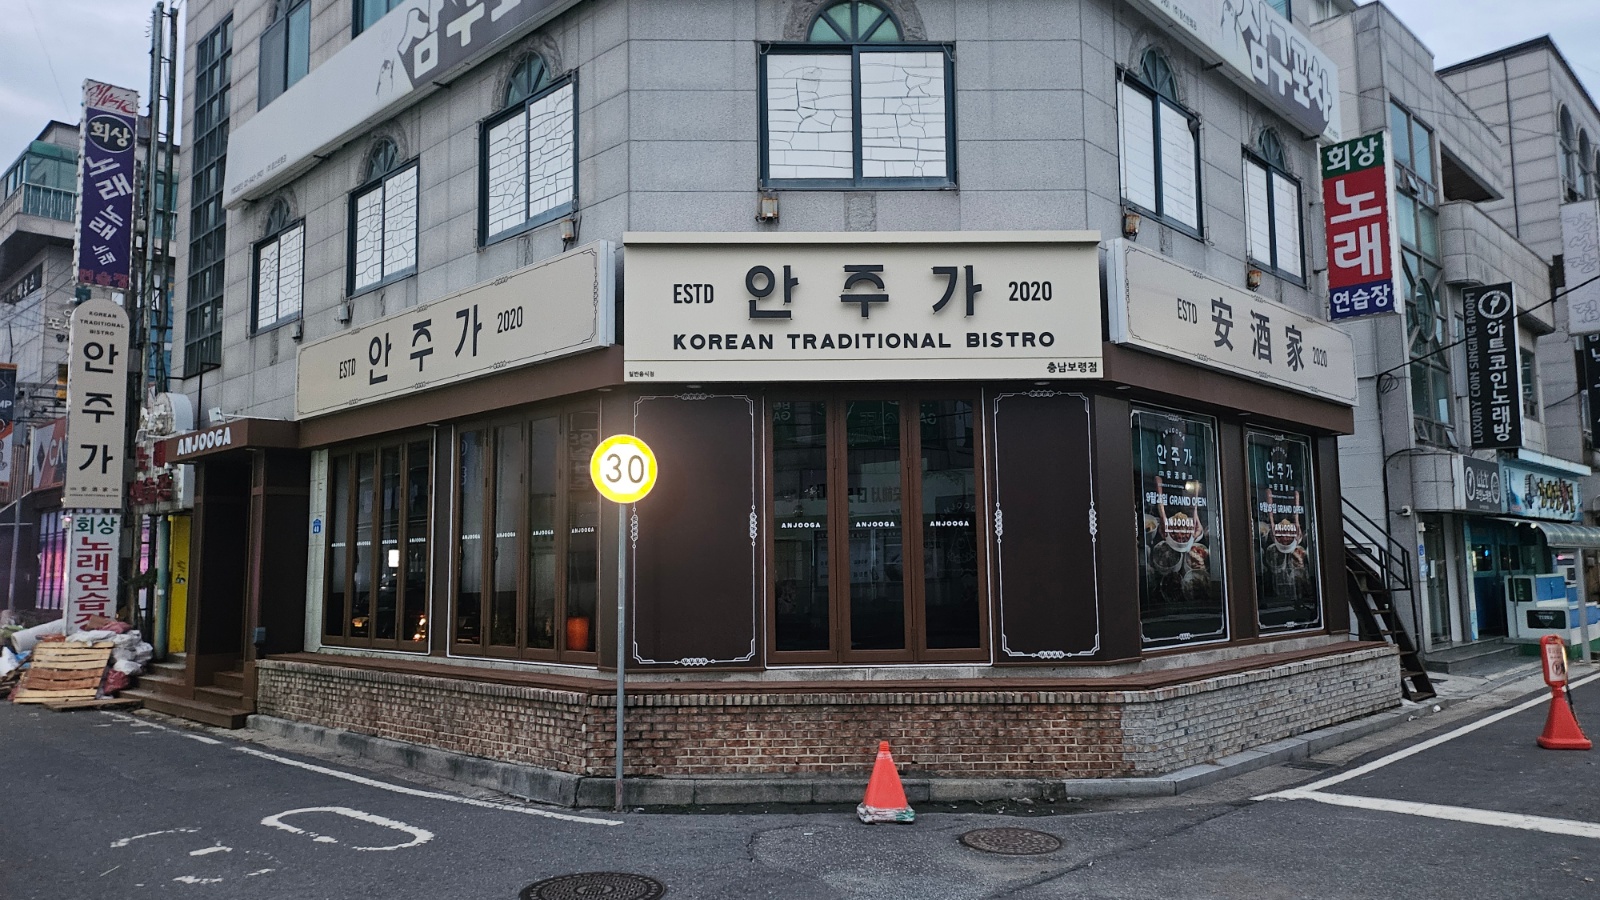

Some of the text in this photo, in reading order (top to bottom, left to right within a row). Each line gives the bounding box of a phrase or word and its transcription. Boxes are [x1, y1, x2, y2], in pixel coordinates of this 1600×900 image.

[90, 121, 131, 147] 회상
[1326, 137, 1379, 171] 회상
[86, 156, 133, 200] 노래
[88, 204, 124, 240] 노래
[1330, 179, 1383, 276] 노래
[92, 245, 117, 266] 노래
[673, 264, 1052, 320] ESTD 안주가 2020
[1332, 283, 1390, 315] 연습장
[88, 311, 117, 319] KOREAN
[1464, 292, 1476, 323] ROOM
[80, 318, 125, 328] TRADITIONAL
[1177, 297, 1328, 372] ESTD 安酒家 2020
[339, 304, 523, 385] ESTD 안주가 2020
[673, 331, 1055, 351] KOREAN TRADITIONAL BISTRO
[1047, 361, 1097, 373] 충남보령점
[1469, 371, 1481, 397] COIN
[78, 341, 119, 474] 안주가
[1472, 401, 1484, 444] LUXURY
[177, 426, 231, 456] ANJOOGA
[1156, 444, 1192, 467] 안주가
[605, 452, 645, 484] 30
[1266, 461, 1293, 480] 안주가
[1169, 494, 1191, 507] GRAND
[1191, 496, 1207, 507] OPEN
[75, 516, 117, 535] 회상
[1164, 518, 1194, 527] ANJOOGA
